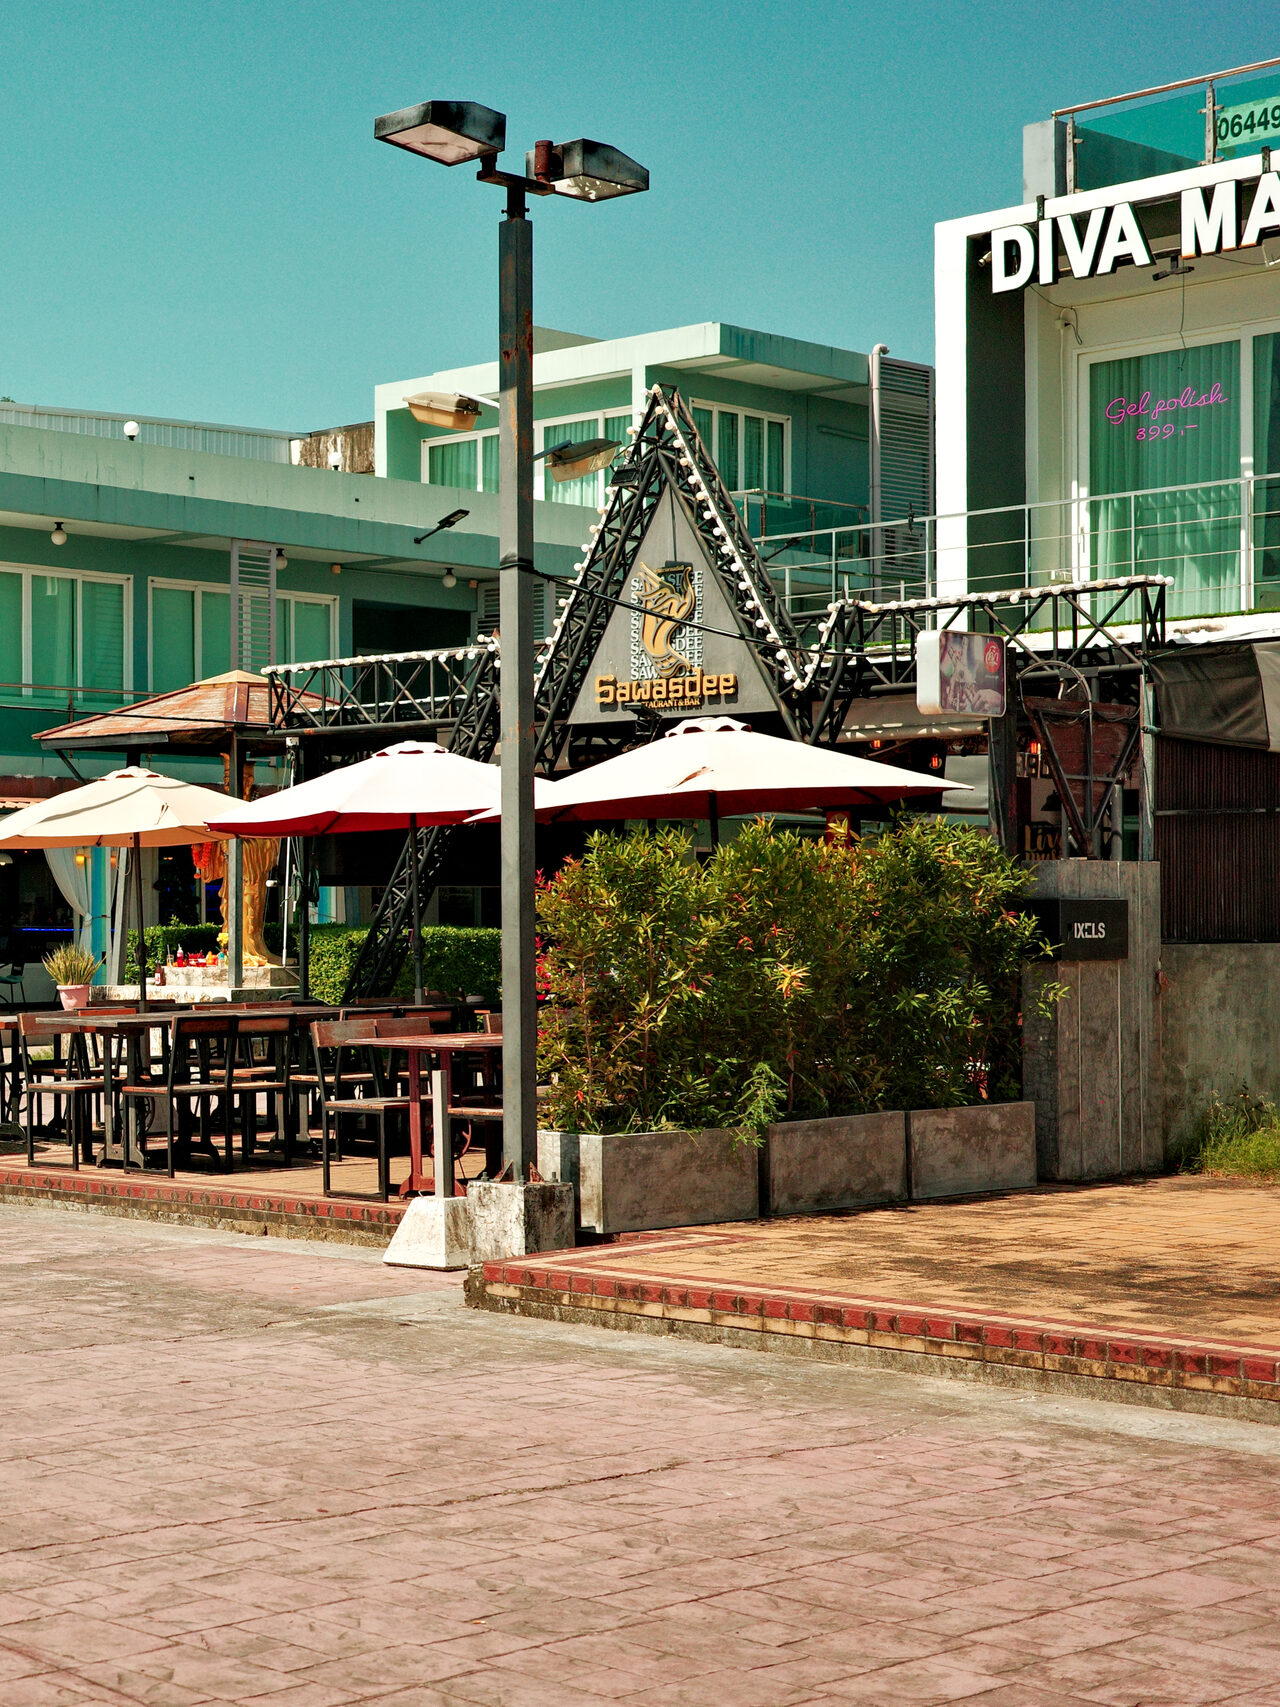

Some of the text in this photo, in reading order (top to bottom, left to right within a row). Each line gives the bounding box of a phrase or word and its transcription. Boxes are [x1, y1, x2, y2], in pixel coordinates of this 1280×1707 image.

[1218, 105, 1280, 141] 06449
[990, 170, 1280, 294] DIVA MA
[1105, 382, 1228, 425] Gel polish
